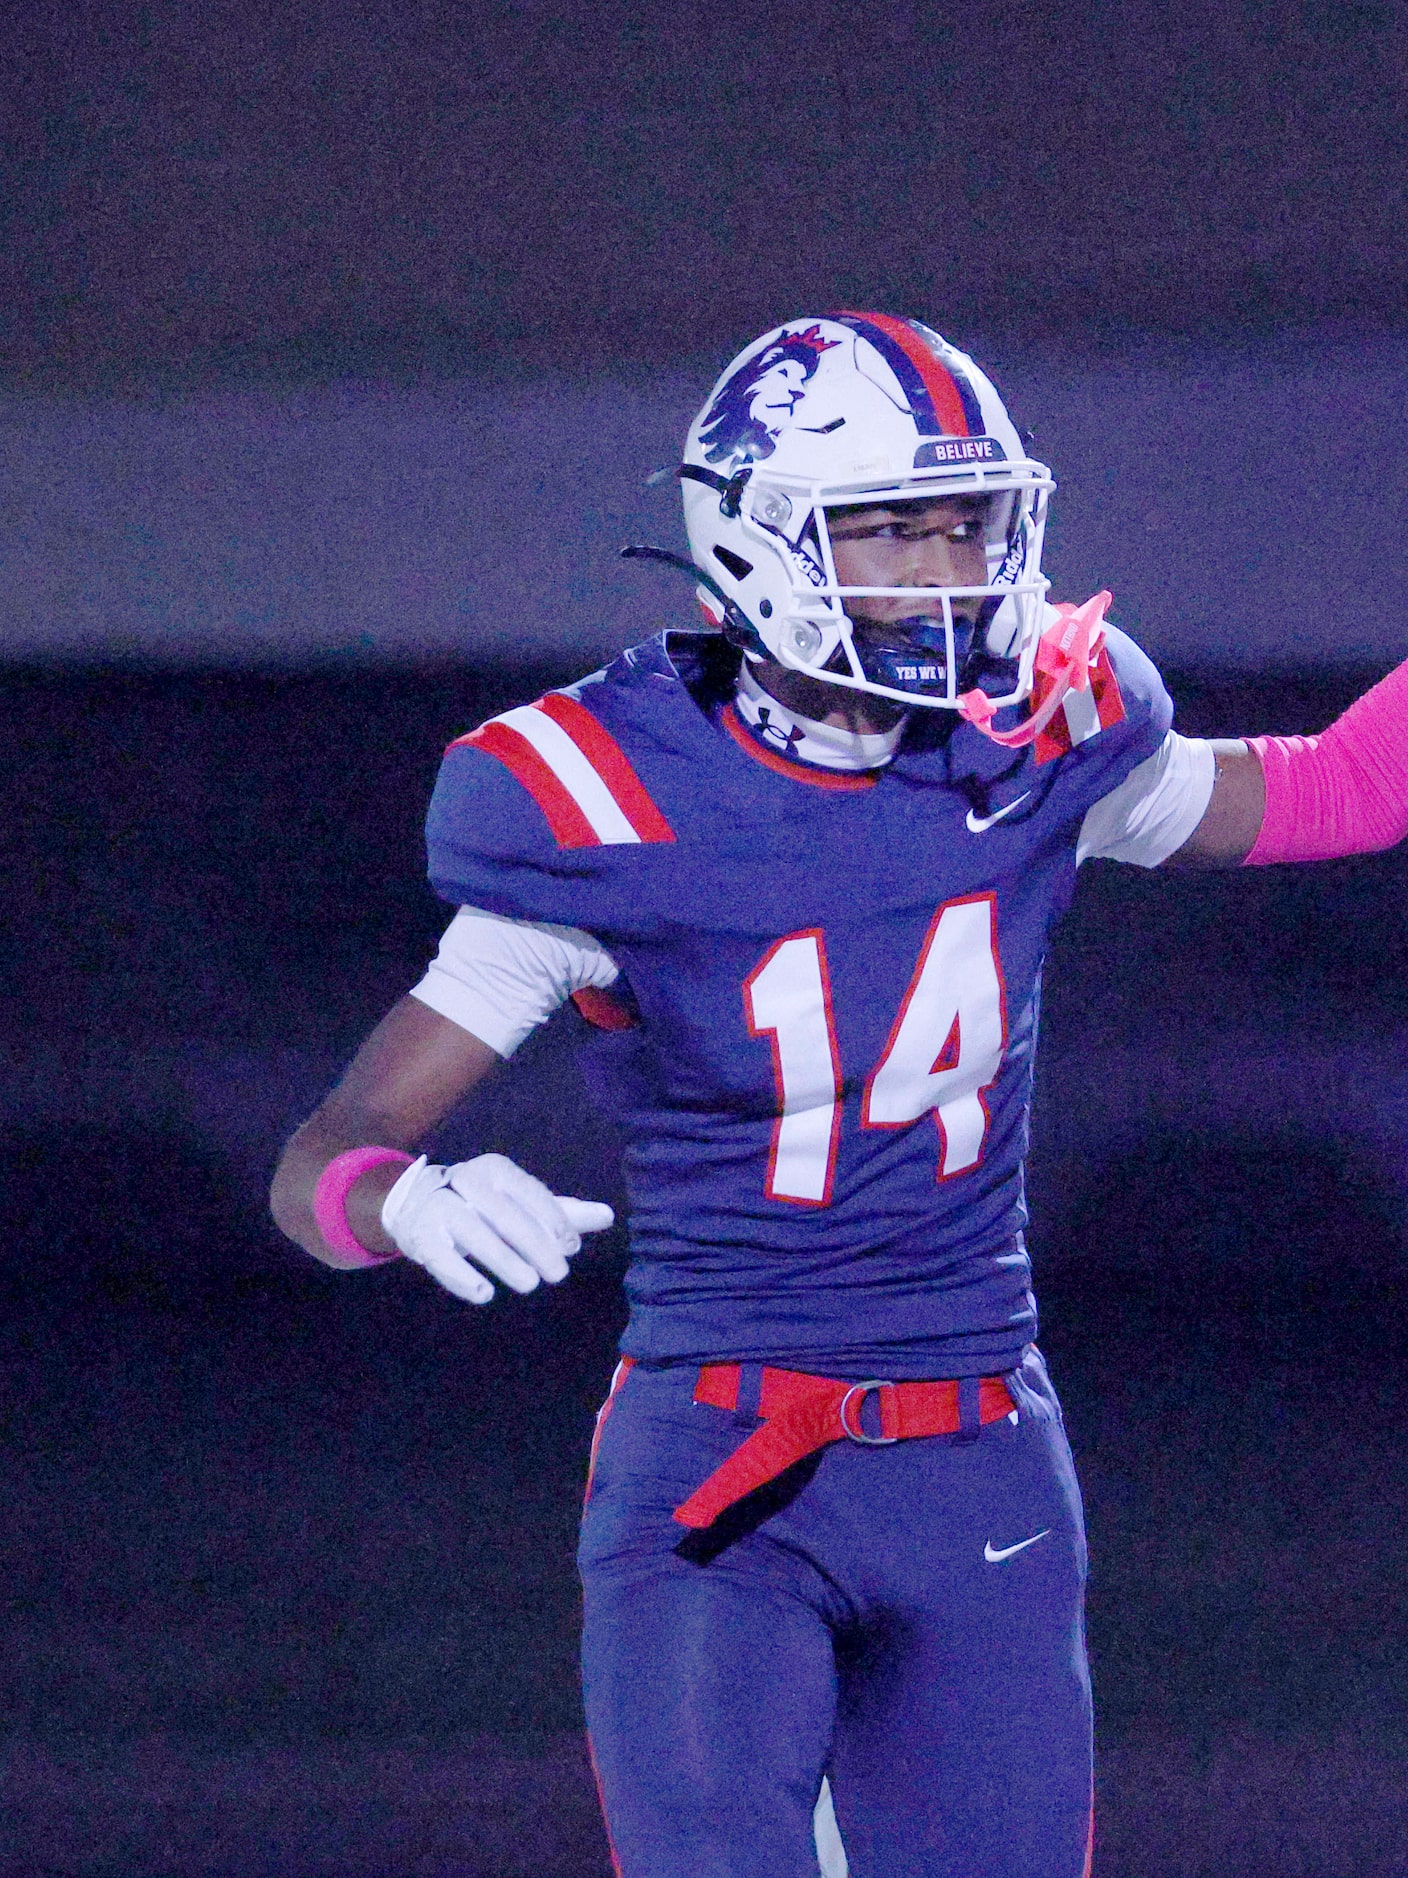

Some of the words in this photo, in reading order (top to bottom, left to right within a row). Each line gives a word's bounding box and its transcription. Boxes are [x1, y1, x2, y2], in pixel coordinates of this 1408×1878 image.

[935, 442, 993, 460] BELIEVE
[896, 666, 917, 680] YES
[918, 666, 936, 680] WE
[743, 892, 1007, 1207] 14
